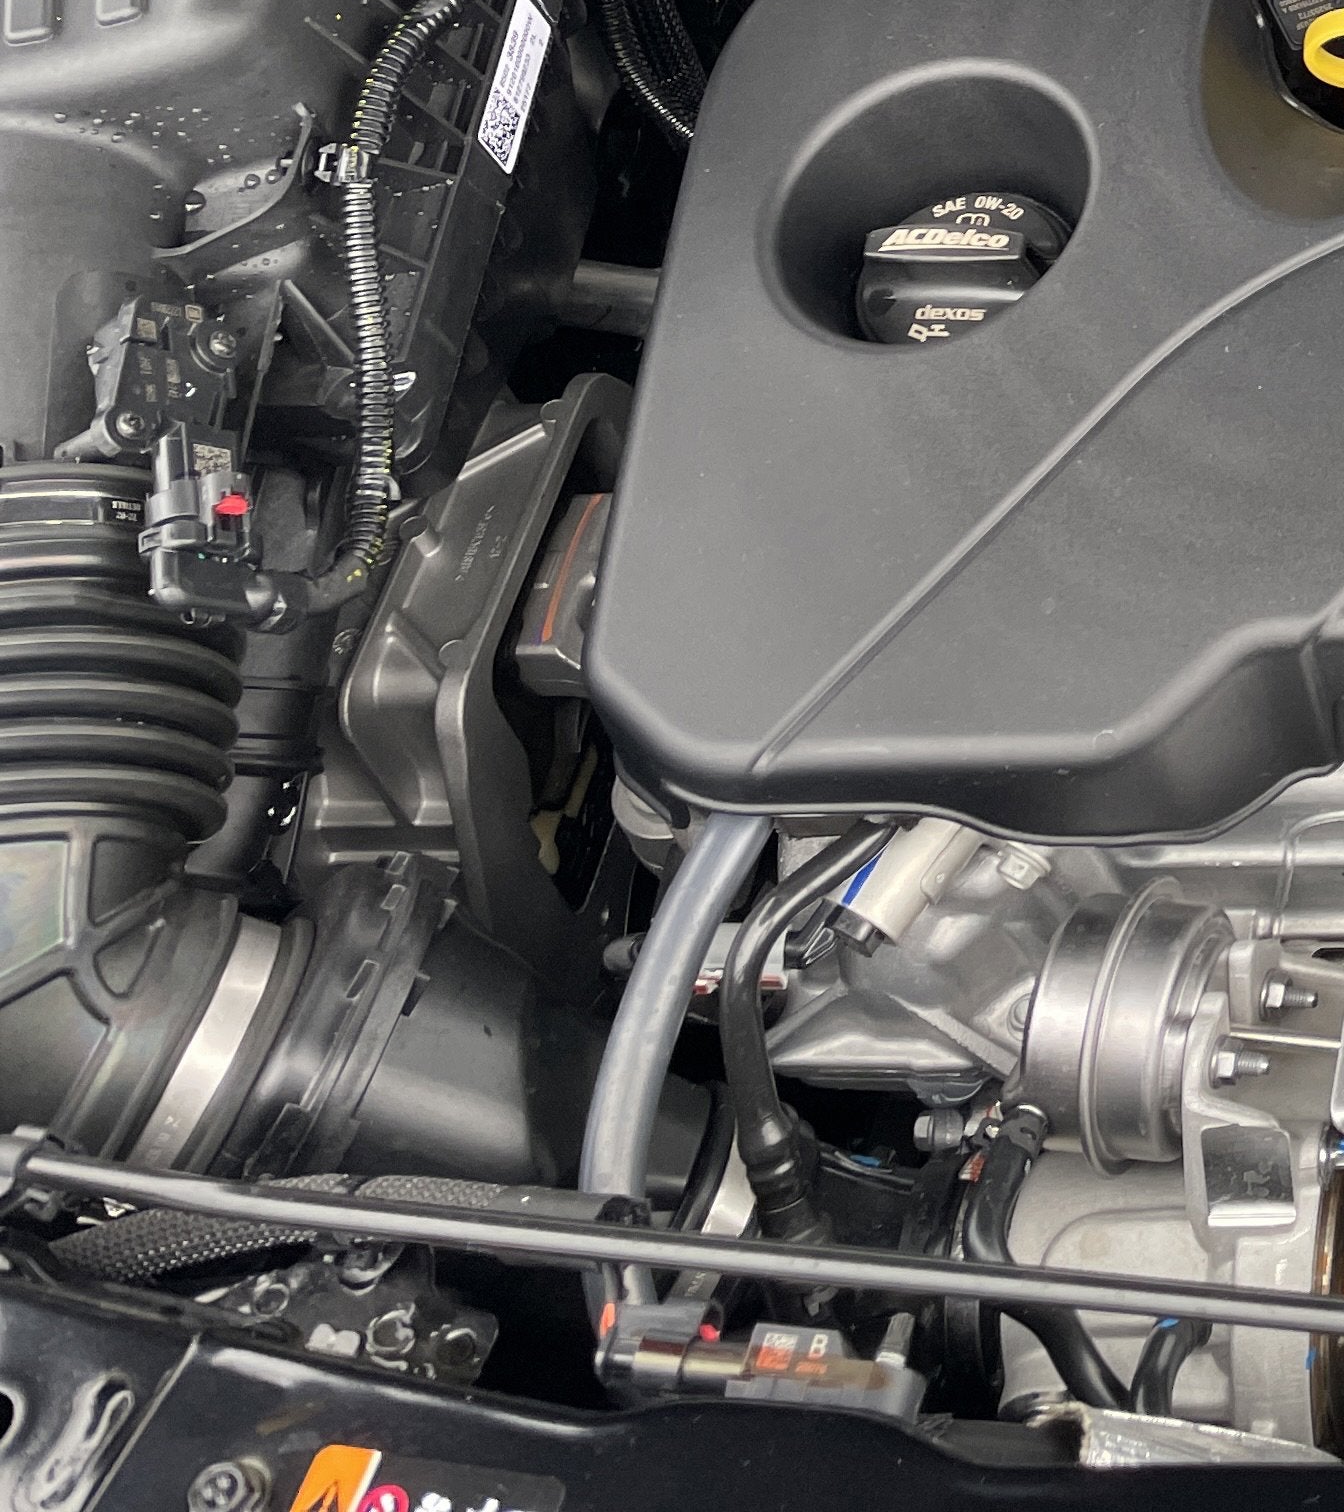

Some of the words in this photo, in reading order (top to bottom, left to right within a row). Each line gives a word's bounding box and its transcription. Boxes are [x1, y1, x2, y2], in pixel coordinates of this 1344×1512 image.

[931, 196, 967, 218] SAE
[974, 195, 1025, 221] 0W-20
[881, 228, 1011, 249] ACDelco
[914, 304, 988, 321] dexos
[807, 1333, 829, 1360] B
